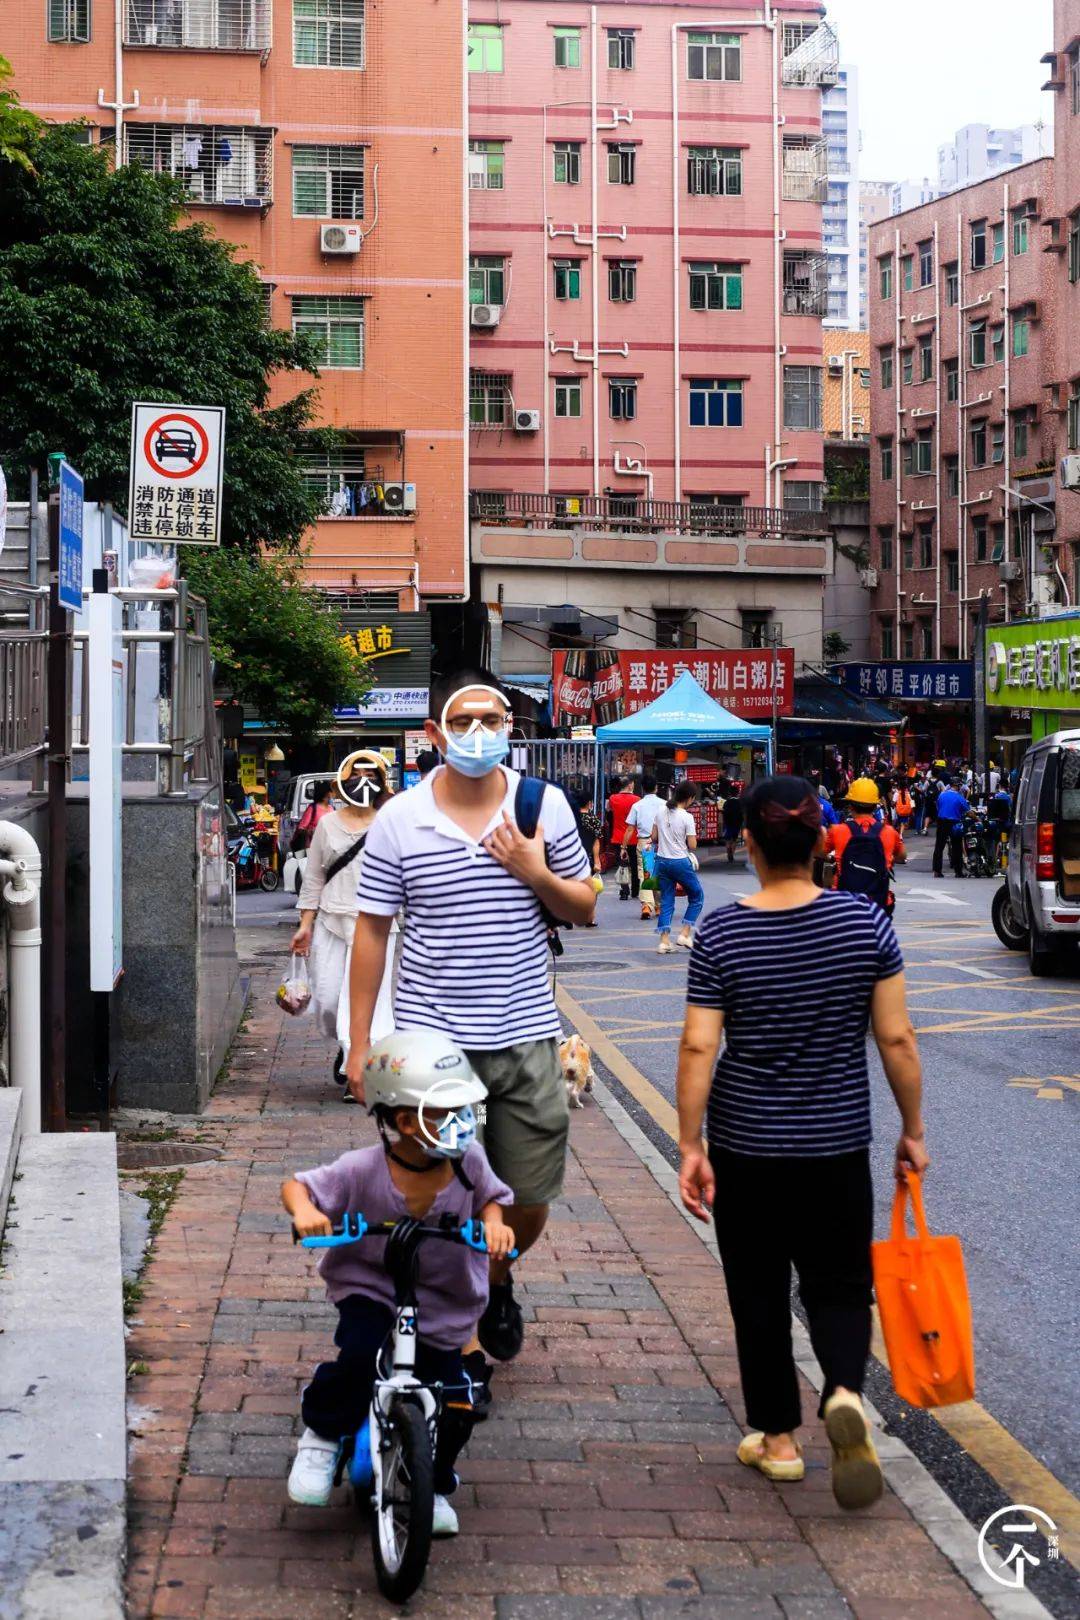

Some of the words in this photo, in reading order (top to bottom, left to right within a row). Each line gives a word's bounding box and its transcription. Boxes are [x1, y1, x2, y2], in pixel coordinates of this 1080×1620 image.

[136, 485, 216, 505] 消防通道
[135, 502, 214, 521] 禁止停车
[134, 518, 214, 538] 违停锁车
[860, 668, 960, 697] 好邻居平价超市
[393, 691, 429, 700] 中通快递
[743, 696, 784, 706] 1571203423
